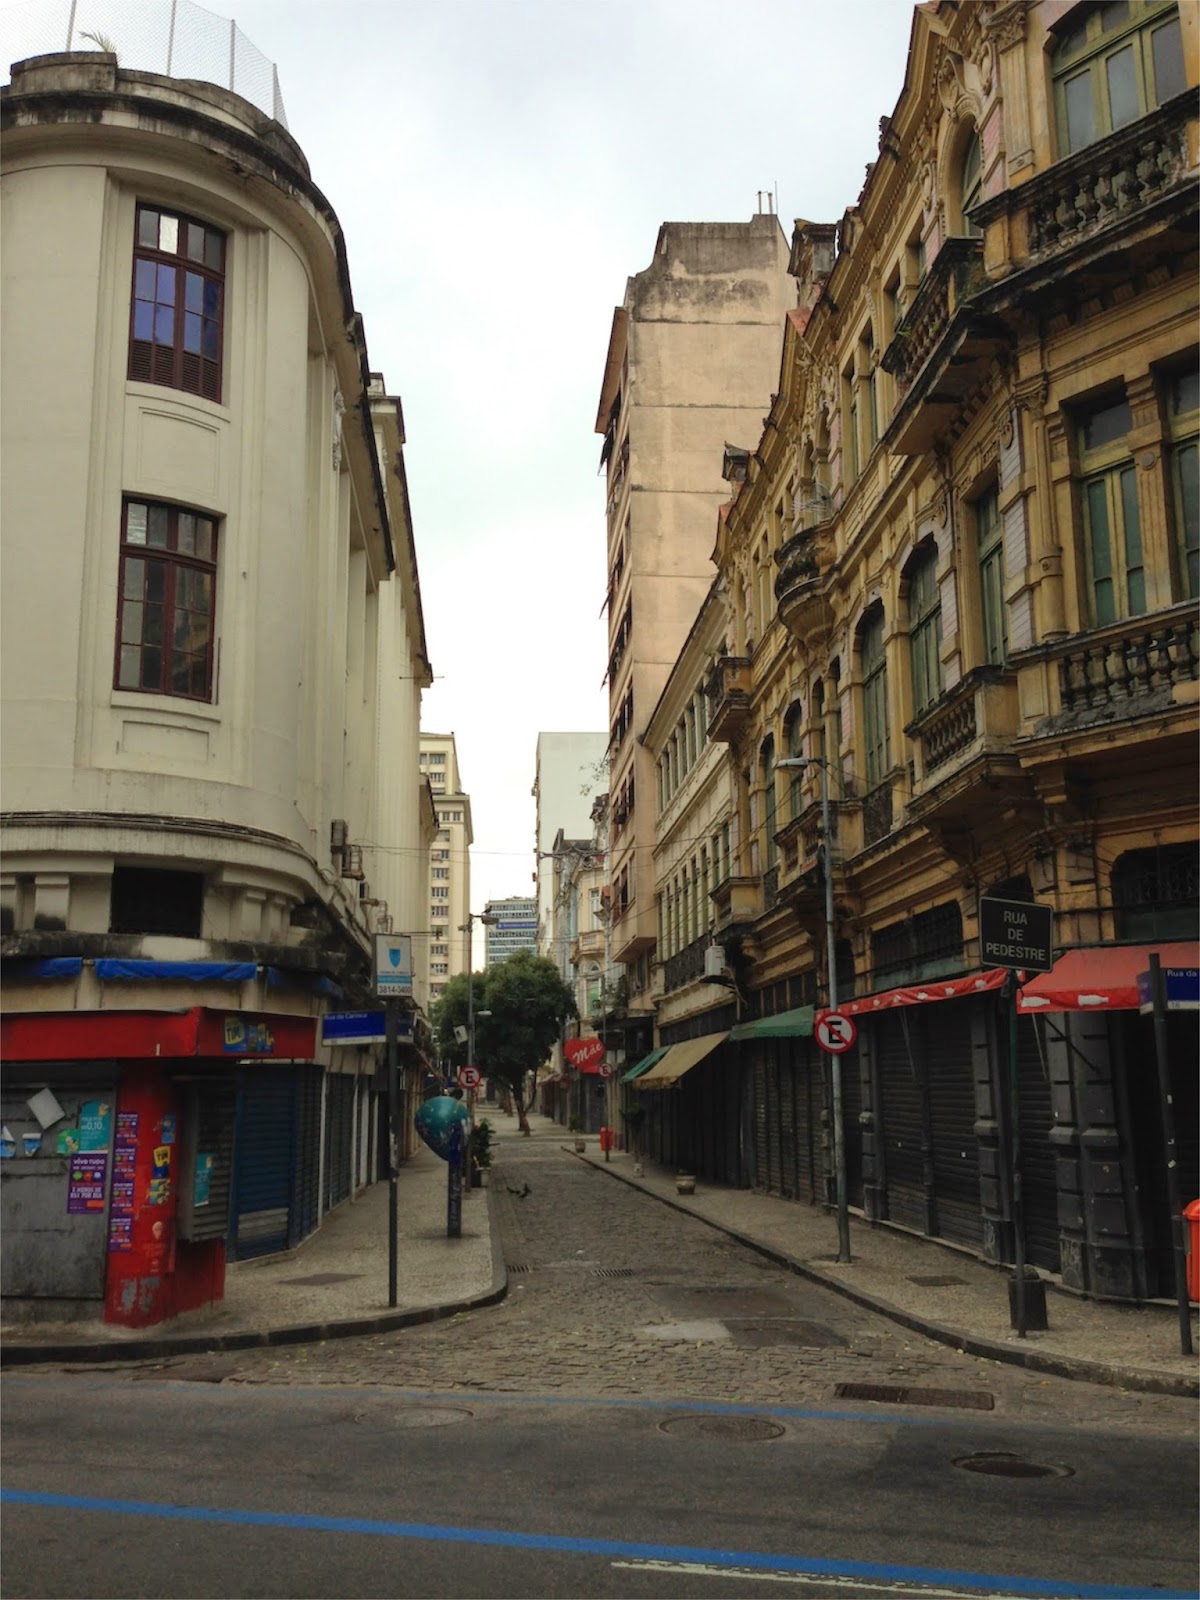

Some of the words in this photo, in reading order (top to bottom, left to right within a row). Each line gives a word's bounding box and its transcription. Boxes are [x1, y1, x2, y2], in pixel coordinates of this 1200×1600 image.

[1003, 910, 1028, 925] RUA
[1007, 928, 1024, 941] DE
[985, 942, 1046, 961] PEDESTRE
[1167, 969, 1185, 977] Rua
[828, 1021, 843, 1044] E
